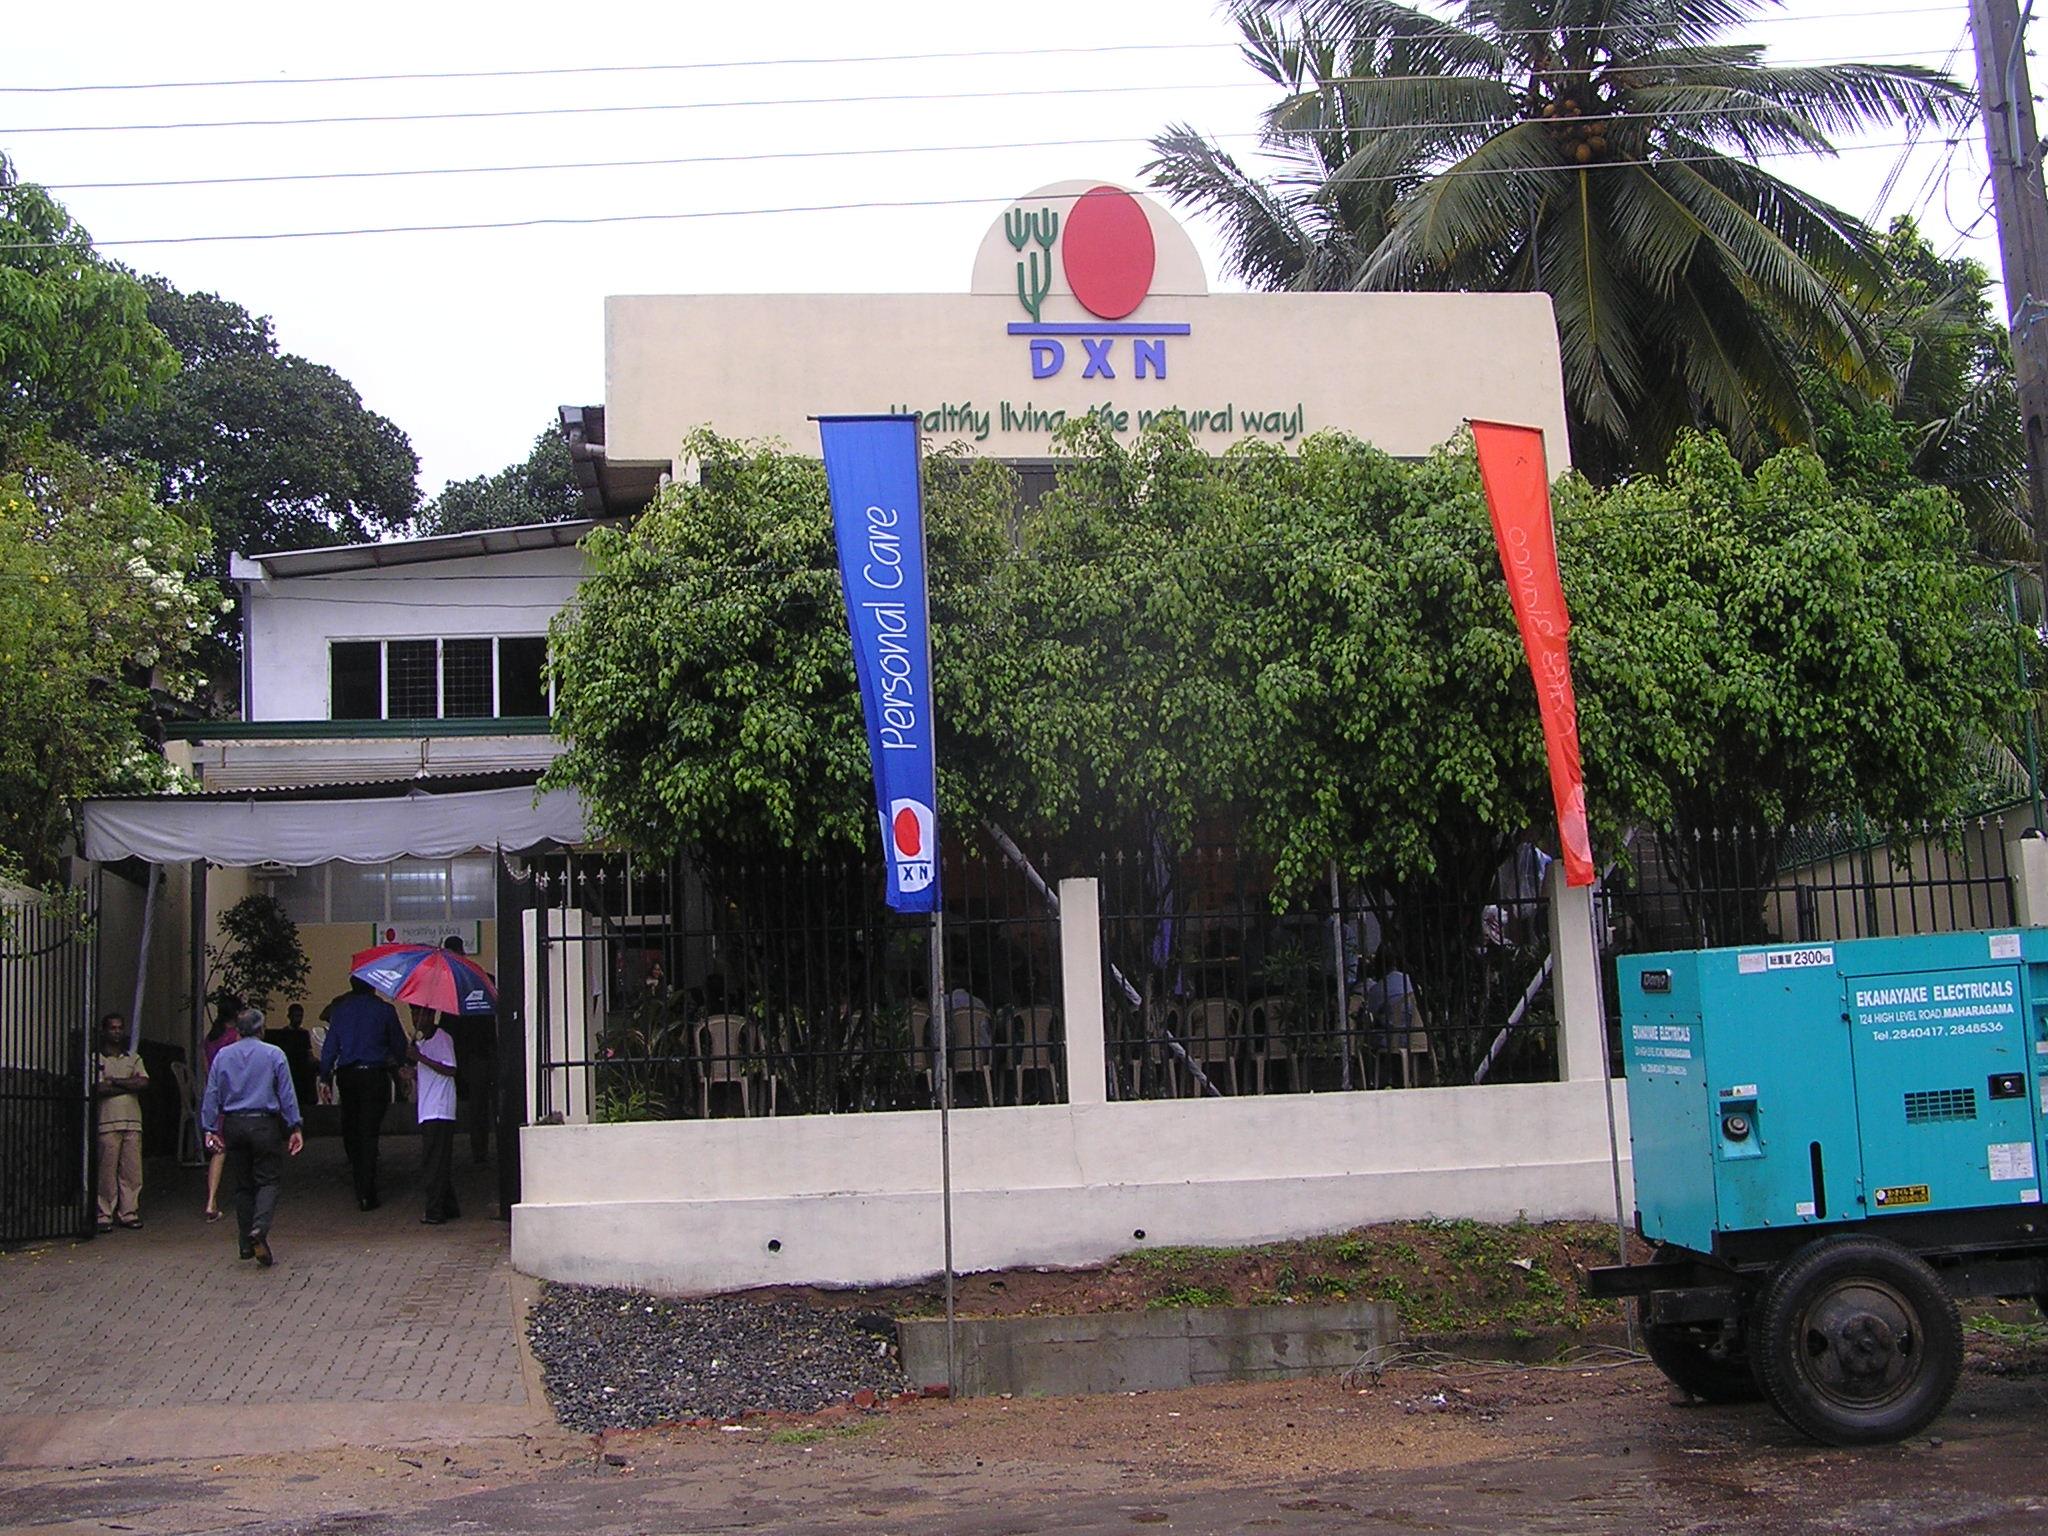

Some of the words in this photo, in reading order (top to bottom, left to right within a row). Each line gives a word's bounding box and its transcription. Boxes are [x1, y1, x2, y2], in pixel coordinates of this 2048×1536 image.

[1029, 339, 1167, 379] DXN
[890, 401, 990, 441] althy
[1138, 402, 1233, 433] nural
[863, 505, 904, 590] Care
[861, 602, 918, 749] Personal
[1856, 986, 1929, 1007] EKANAYAKE
[1933, 981, 2013, 1001] ELECTRICALS
[1859, 1013, 1873, 1025] 124
[1874, 1011, 1894, 1023] HIGH
[1895, 1010, 1917, 1022] LEVEL
